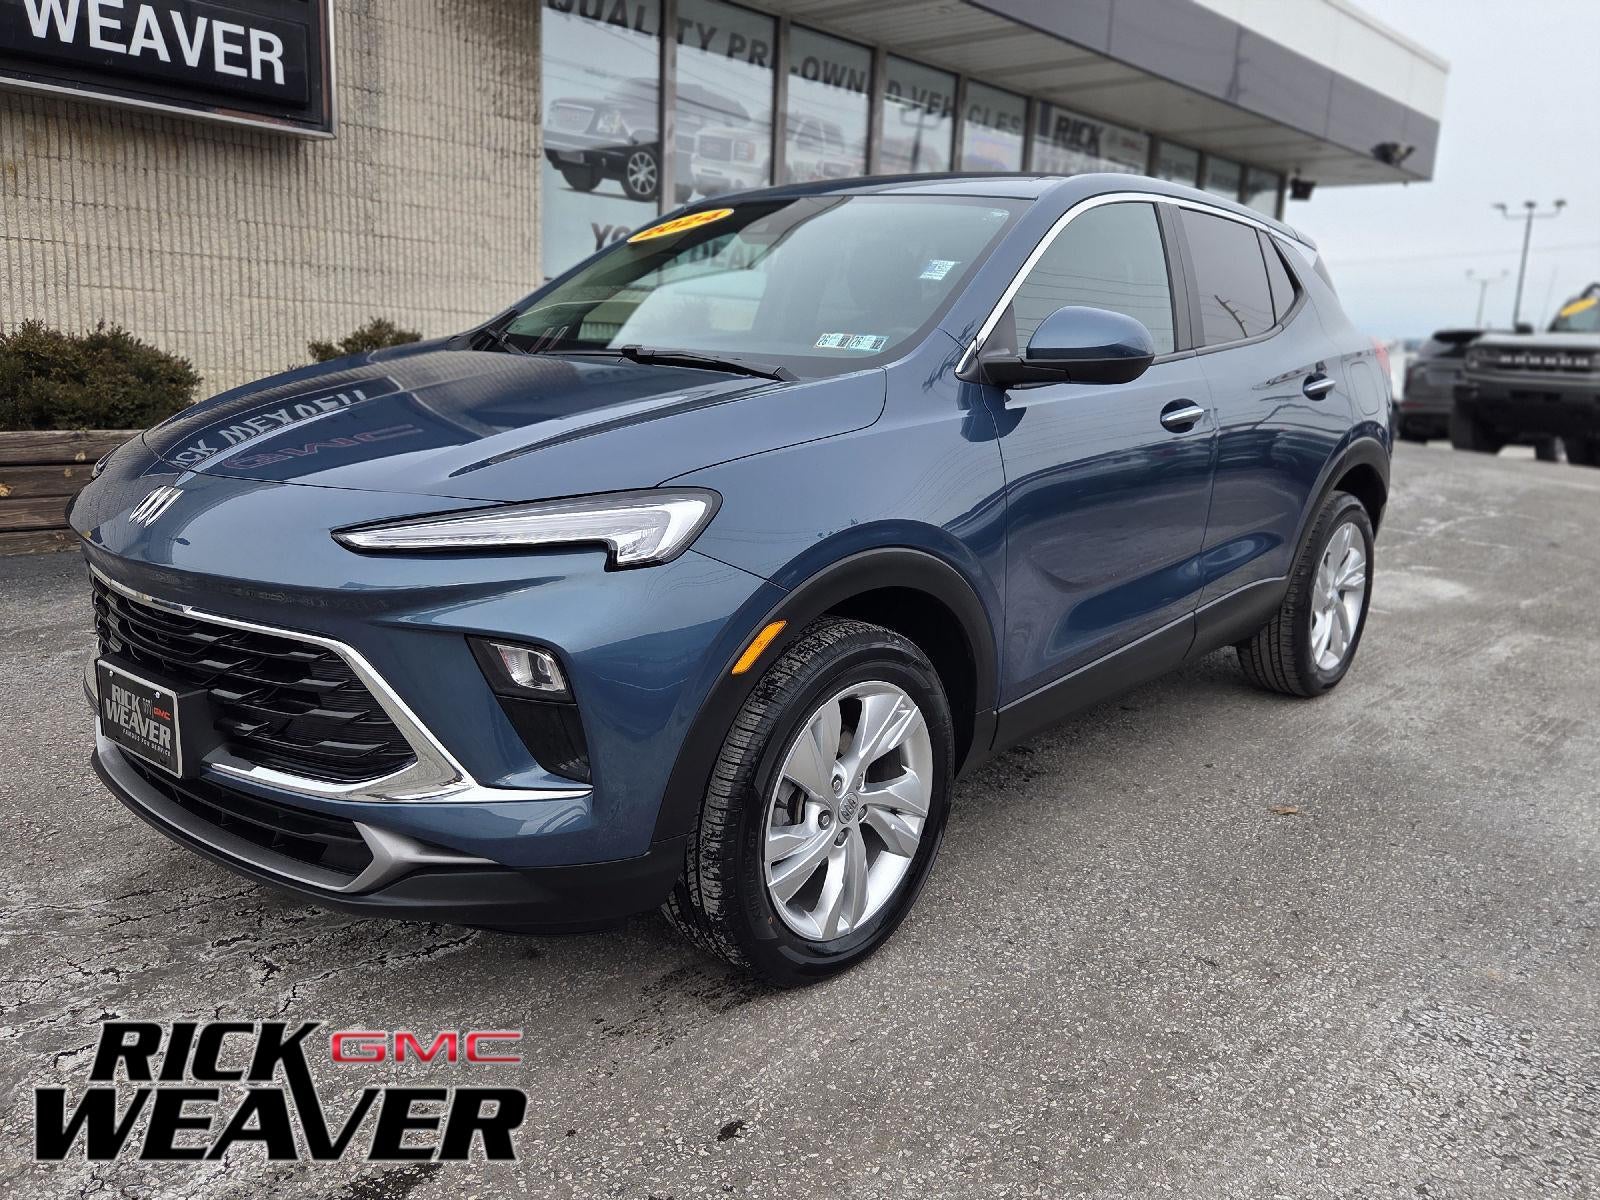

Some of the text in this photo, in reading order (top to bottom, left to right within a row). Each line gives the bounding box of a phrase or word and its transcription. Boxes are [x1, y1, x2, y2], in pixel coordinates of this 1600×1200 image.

[23, 0, 286, 85] WEAVER
[547, 0, 1022, 131] UALTY PR-OWND VEHCLES
[105, 697, 171, 750] WEAVER
[111, 683, 141, 712] RICK
[153, 707, 171, 721] GMC
